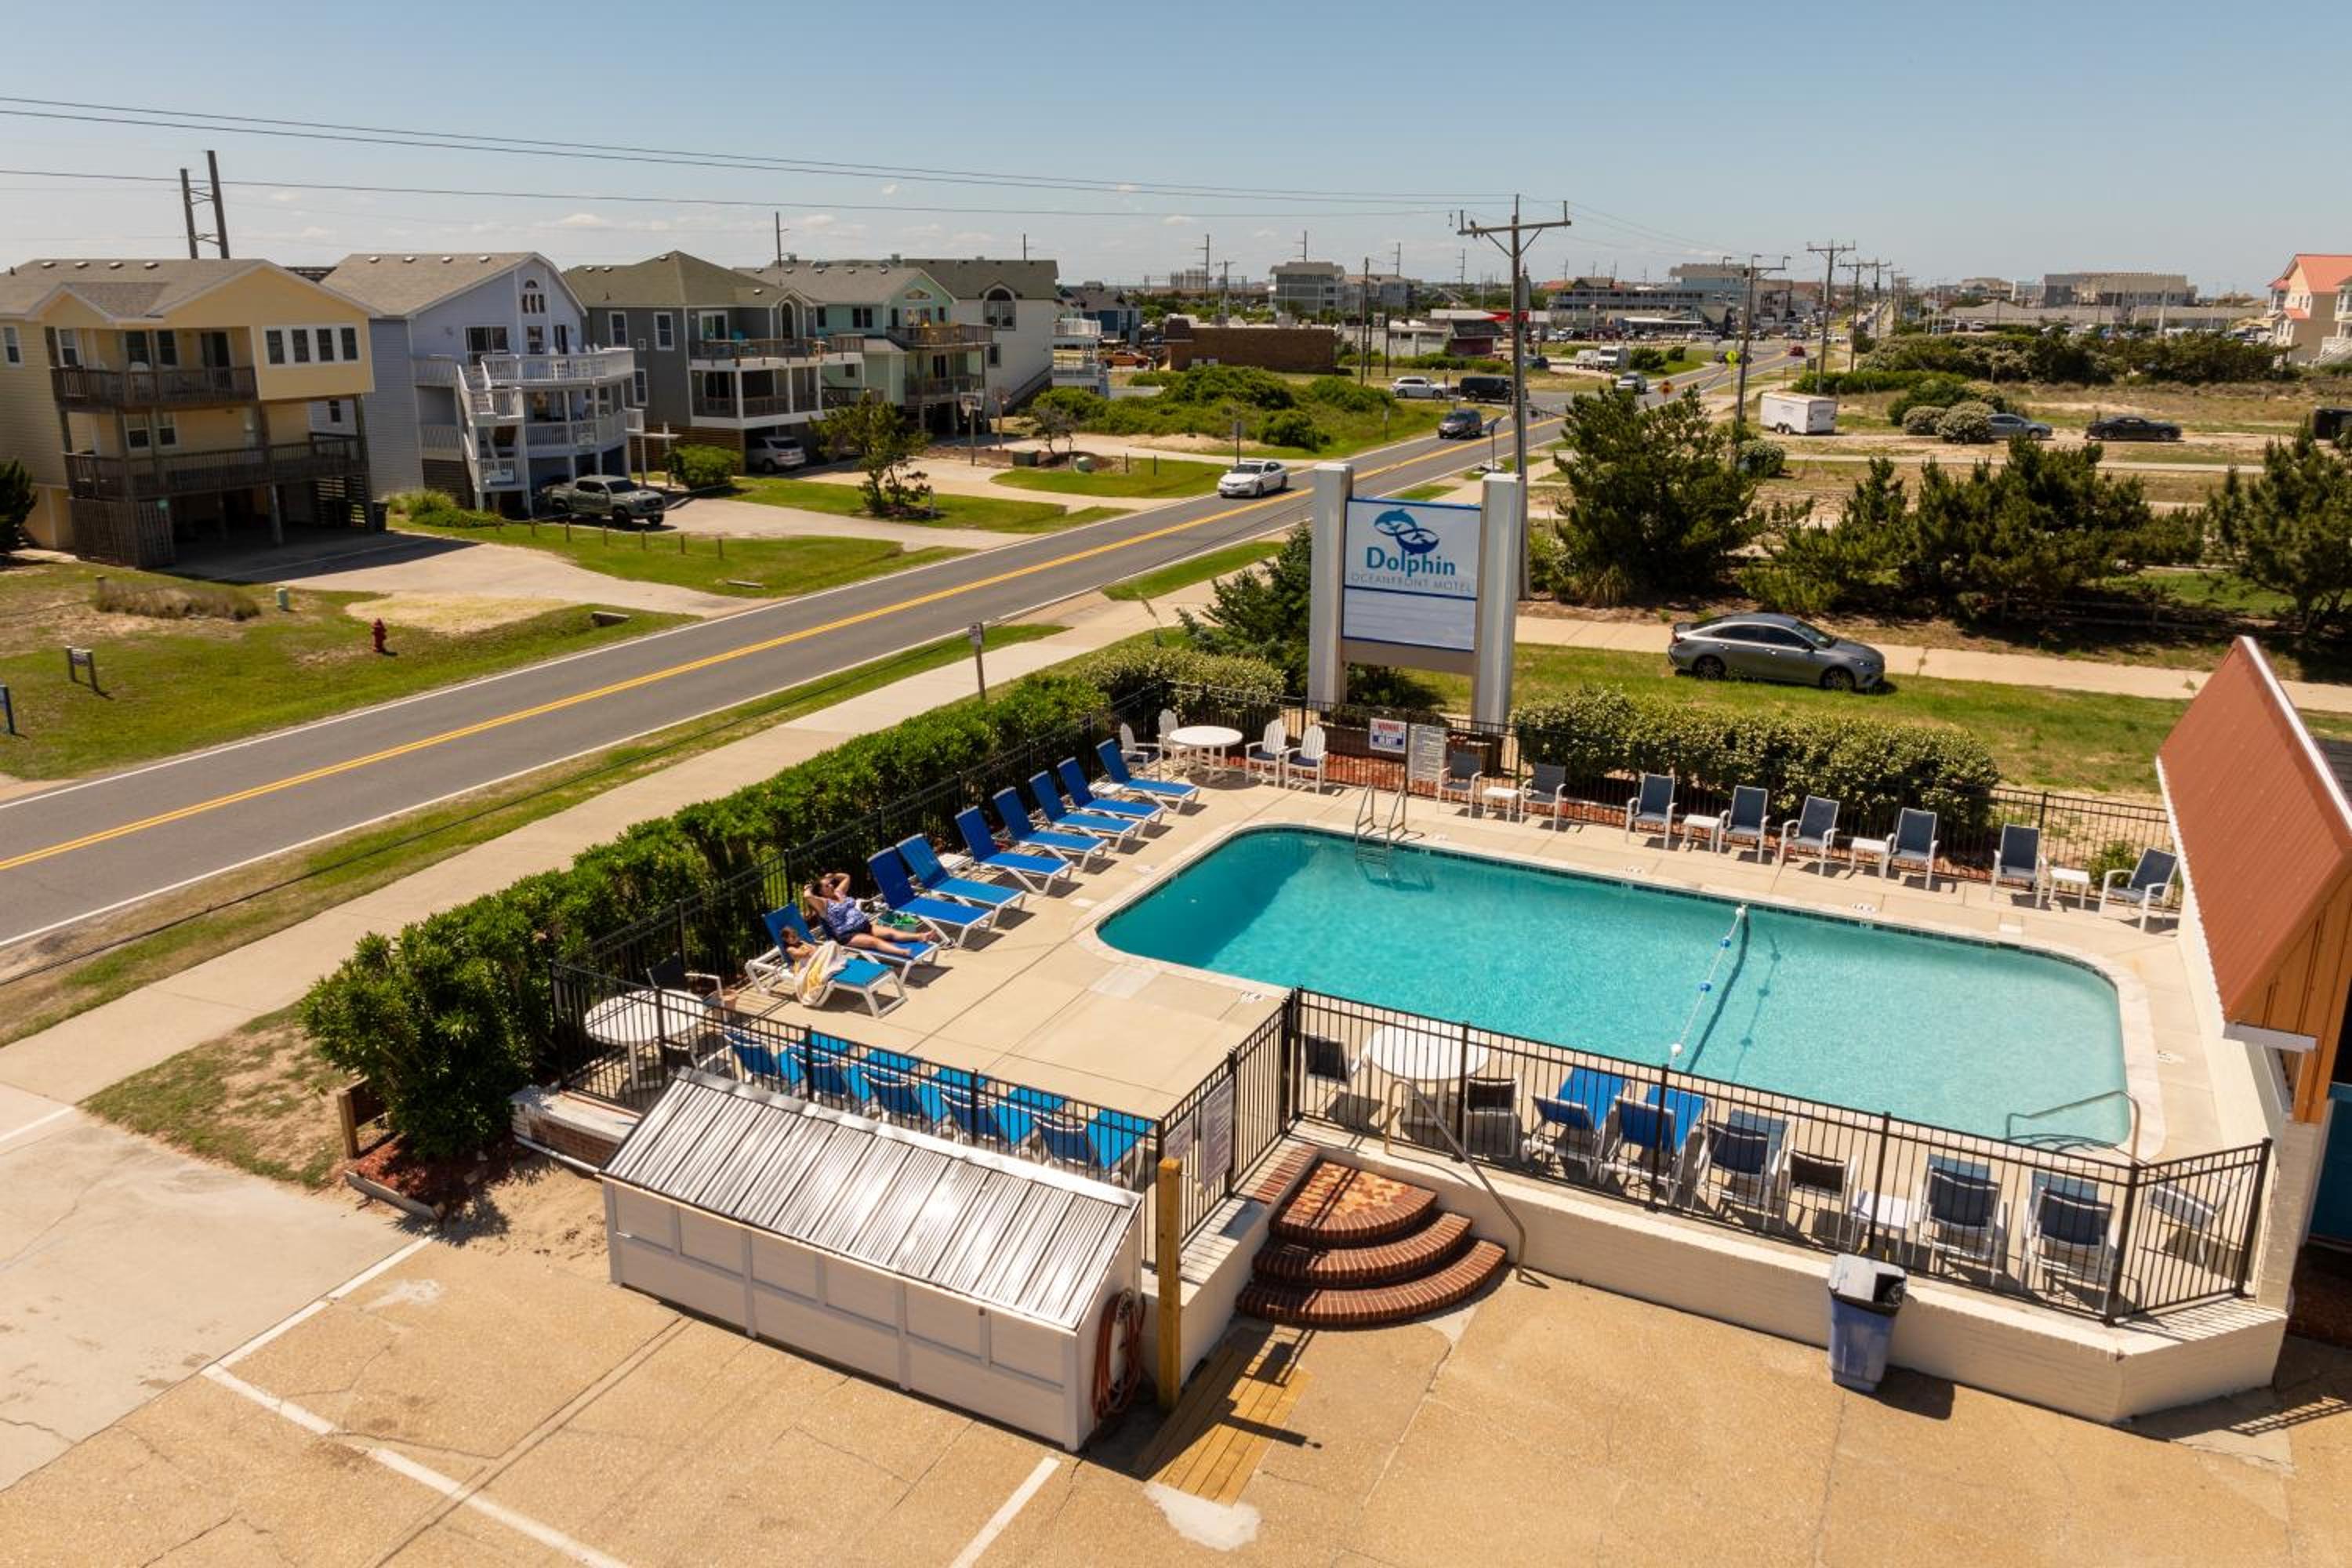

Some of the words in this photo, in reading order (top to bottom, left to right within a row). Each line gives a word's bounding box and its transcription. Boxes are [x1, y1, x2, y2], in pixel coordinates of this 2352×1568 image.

[1367, 546, 1455, 577] Dolphin
[1351, 572, 1428, 588] OCEANFRONT
[1434, 579, 1472, 593] MOTEL
